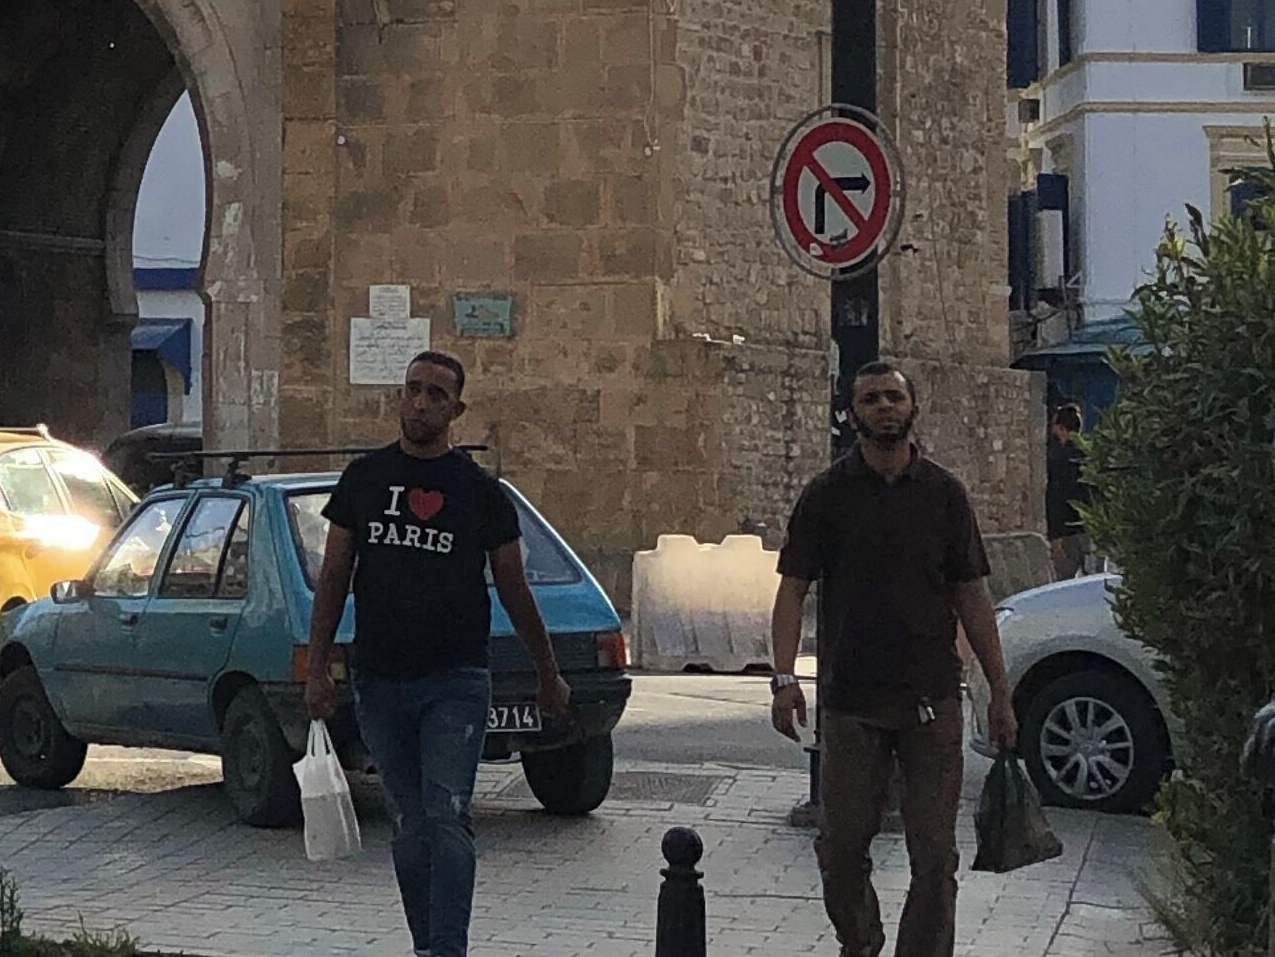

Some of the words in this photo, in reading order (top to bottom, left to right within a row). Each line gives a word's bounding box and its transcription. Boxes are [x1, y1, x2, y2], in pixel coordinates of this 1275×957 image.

[383, 485, 406, 517] I
[367, 521, 454, 554] PARIS
[487, 705, 535, 729] 3714
